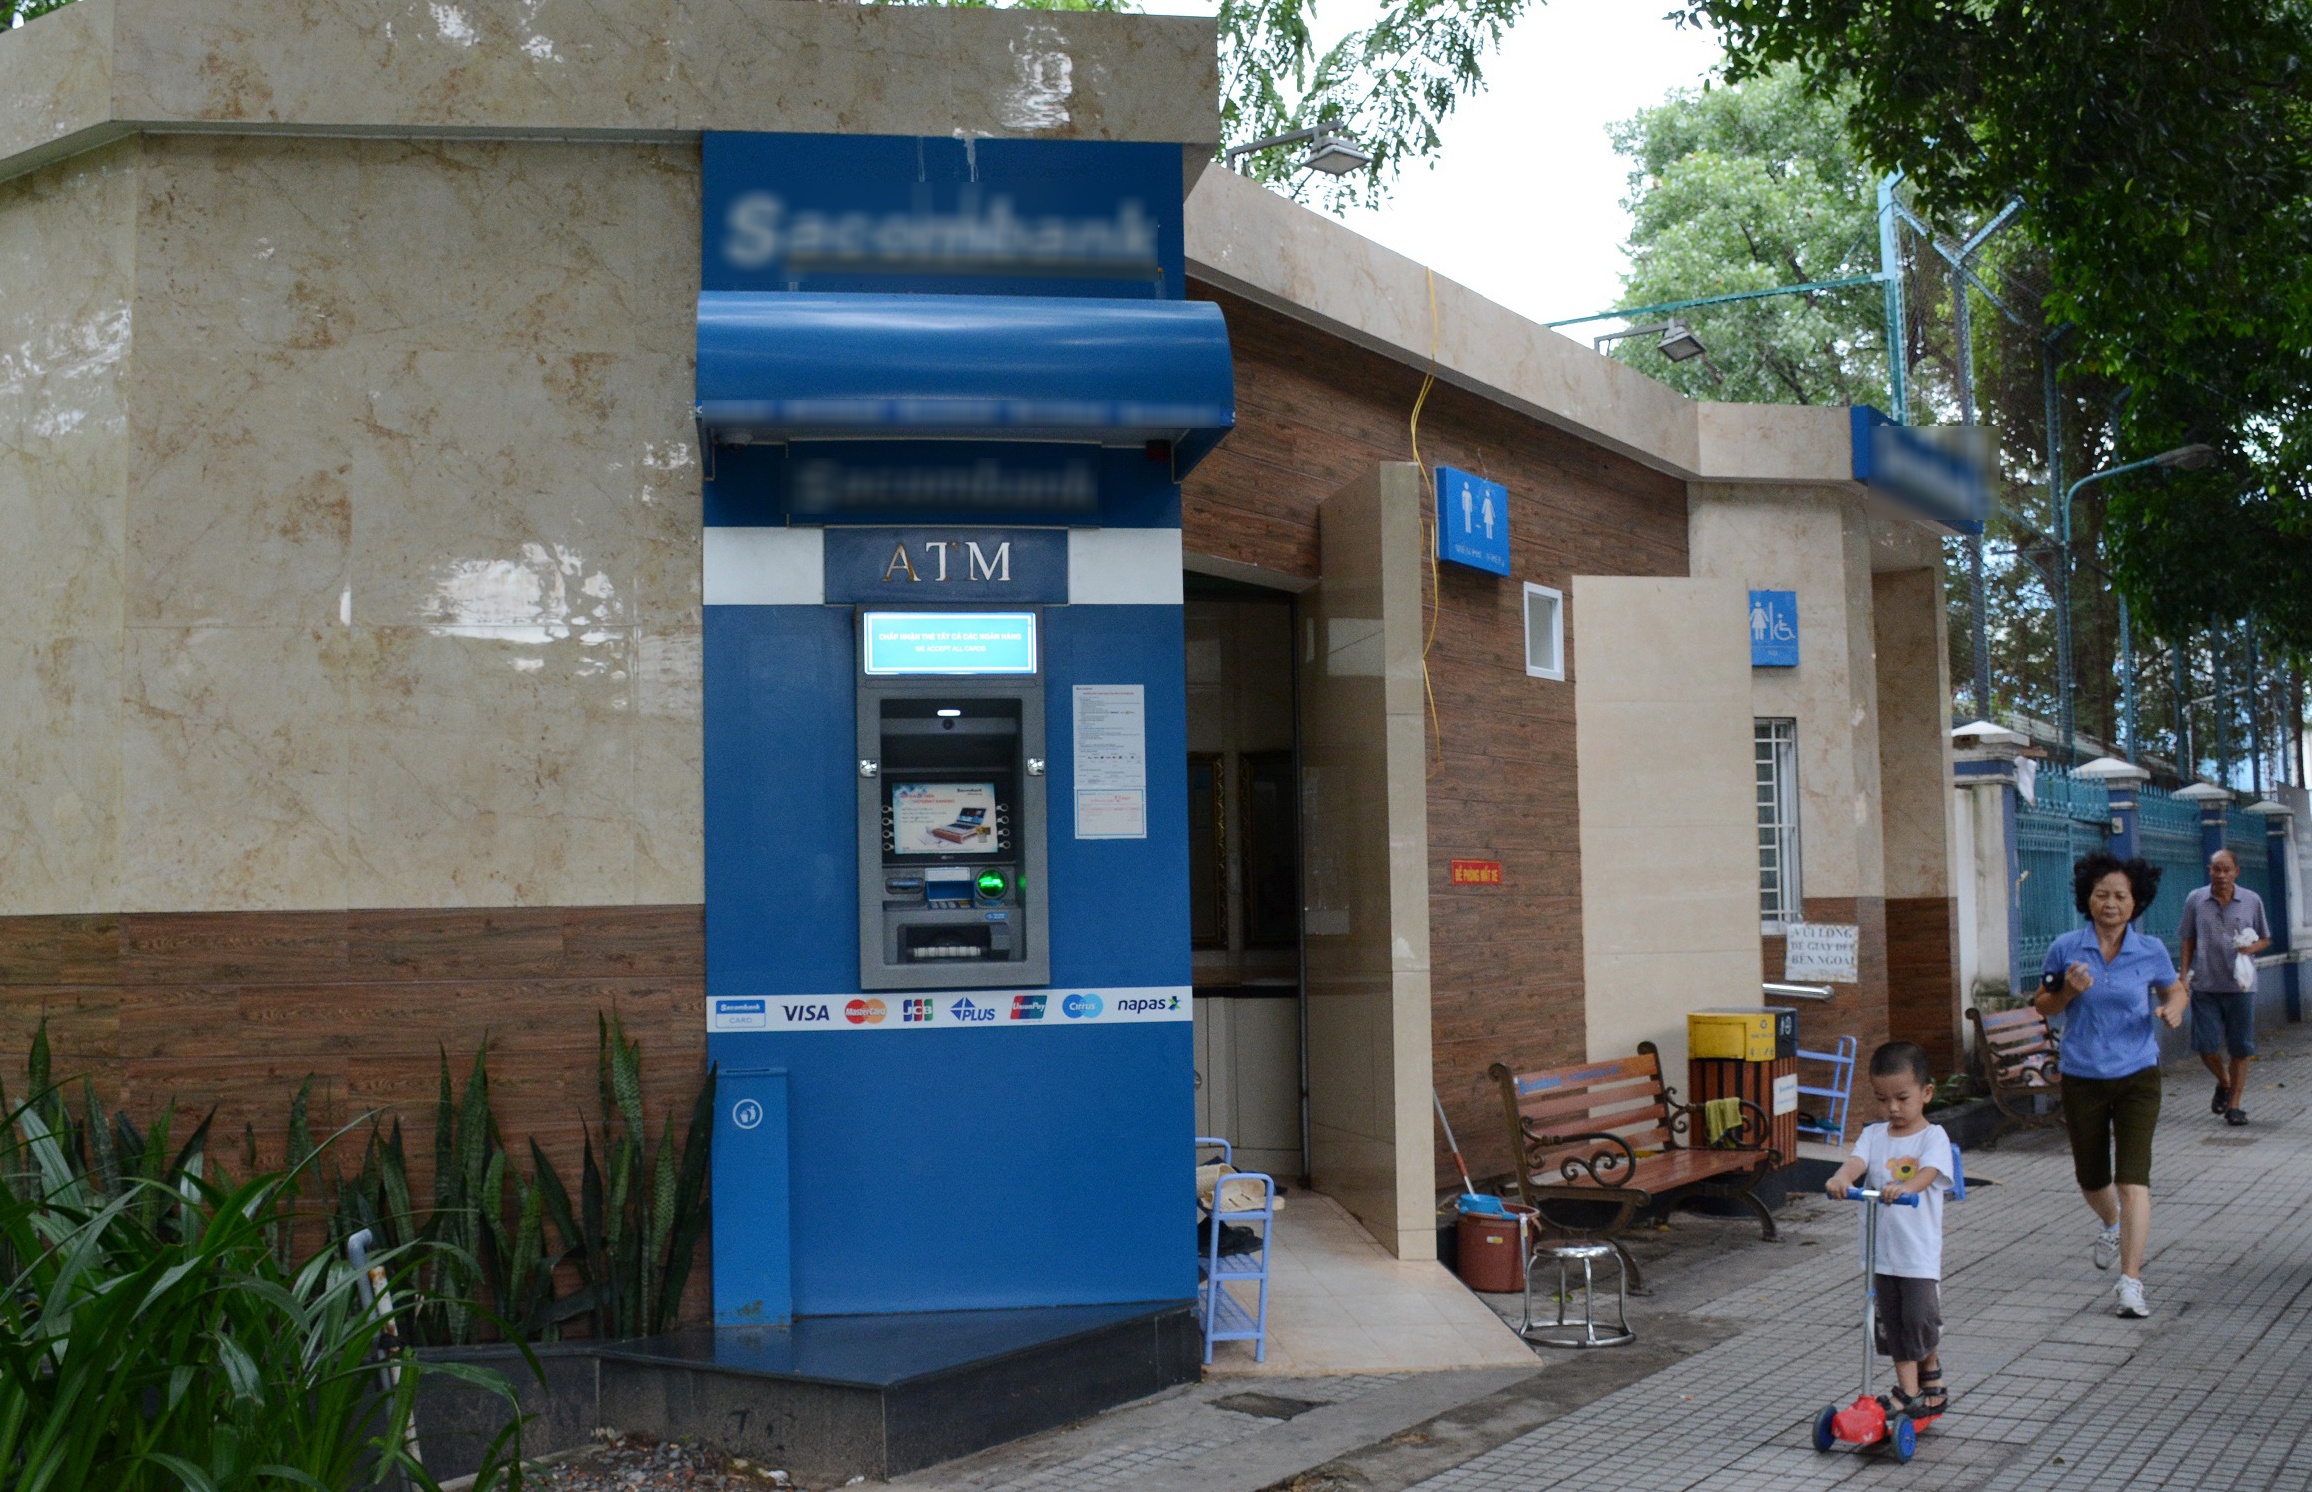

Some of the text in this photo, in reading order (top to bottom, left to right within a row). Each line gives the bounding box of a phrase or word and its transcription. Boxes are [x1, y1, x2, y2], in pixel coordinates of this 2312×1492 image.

[882, 541, 1012, 582] ATM
[781, 1004, 830, 1021] VISA
[845, 1007, 887, 1017] MasterCard
[1012, 1002, 1047, 1012] UnionPay
[1069, 1001, 1096, 1011] Cirrus
[1117, 998, 1167, 1014] napas
[962, 1008, 996, 1021] PLUS
